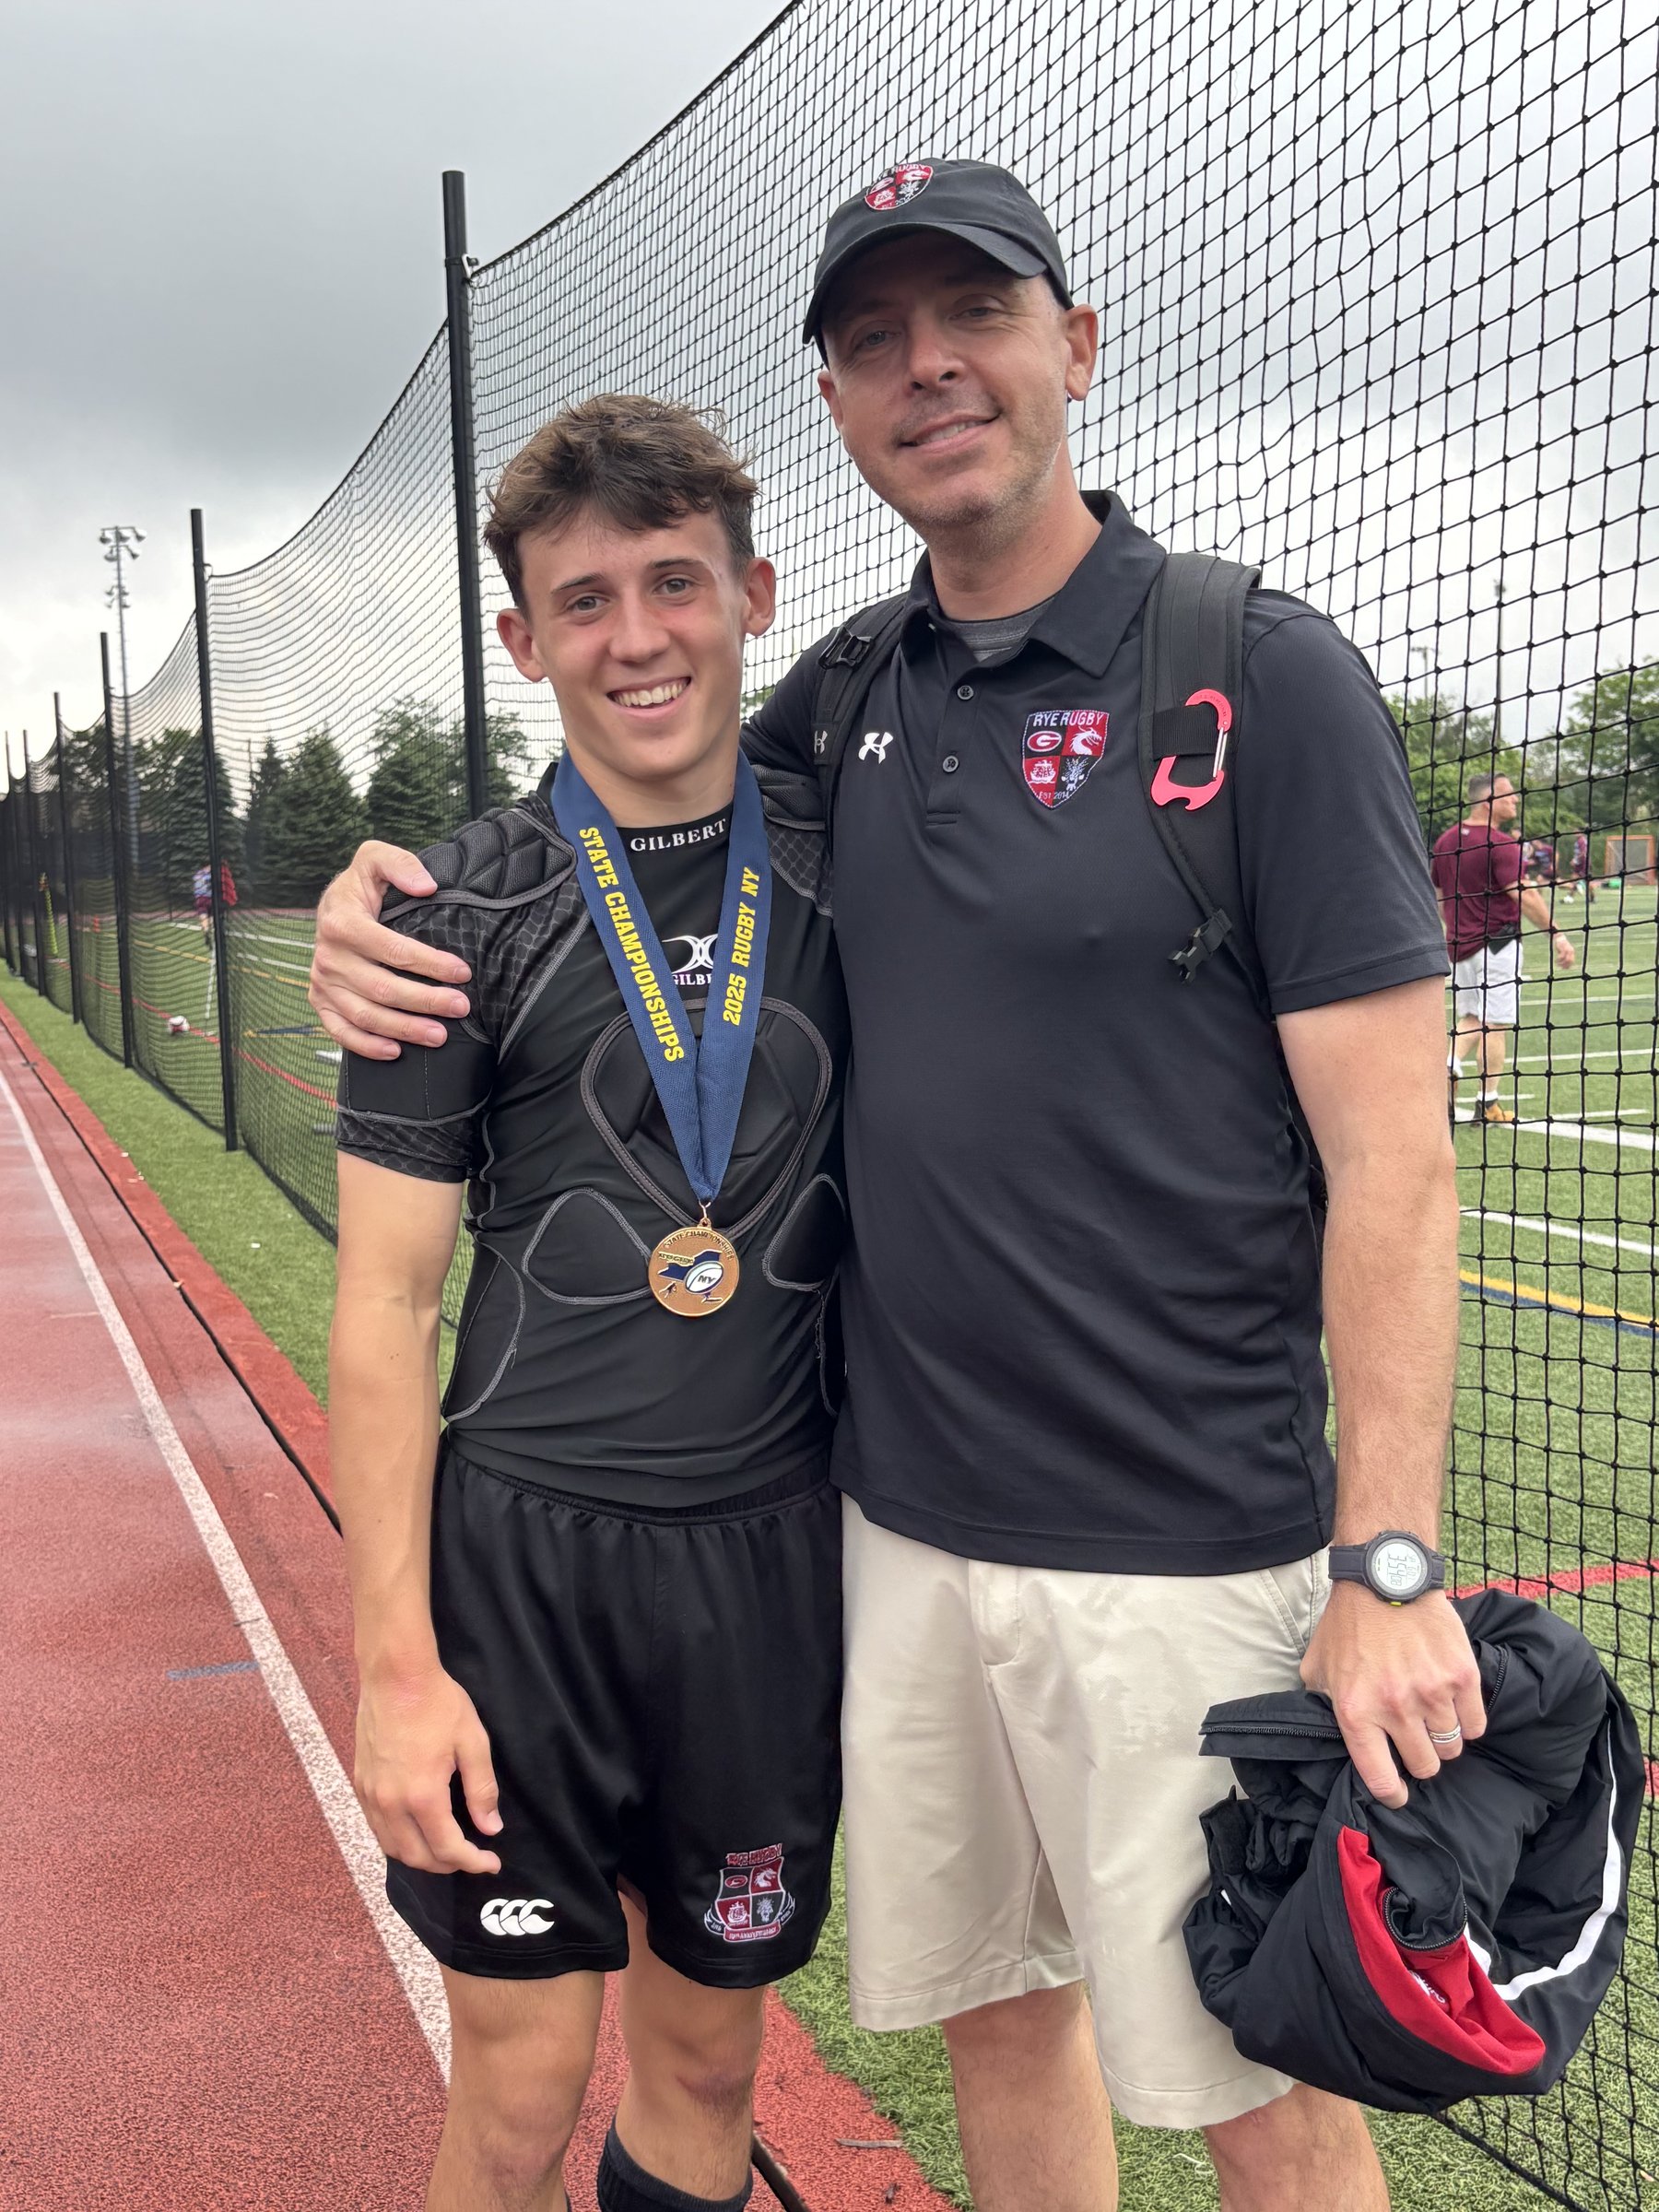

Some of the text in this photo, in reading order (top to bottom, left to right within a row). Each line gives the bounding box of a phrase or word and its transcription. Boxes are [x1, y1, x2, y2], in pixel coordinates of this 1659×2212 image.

[1033, 712, 1103, 726] RYE RUGBY
[630, 818, 726, 852] GILBERT
[579, 827, 685, 1062] STATE CHAMPIONSHIPS
[723, 866, 761, 1026] 2025 RUGBY NY
[672, 973, 712, 985] GILB
[698, 1275, 716, 1284] NY
